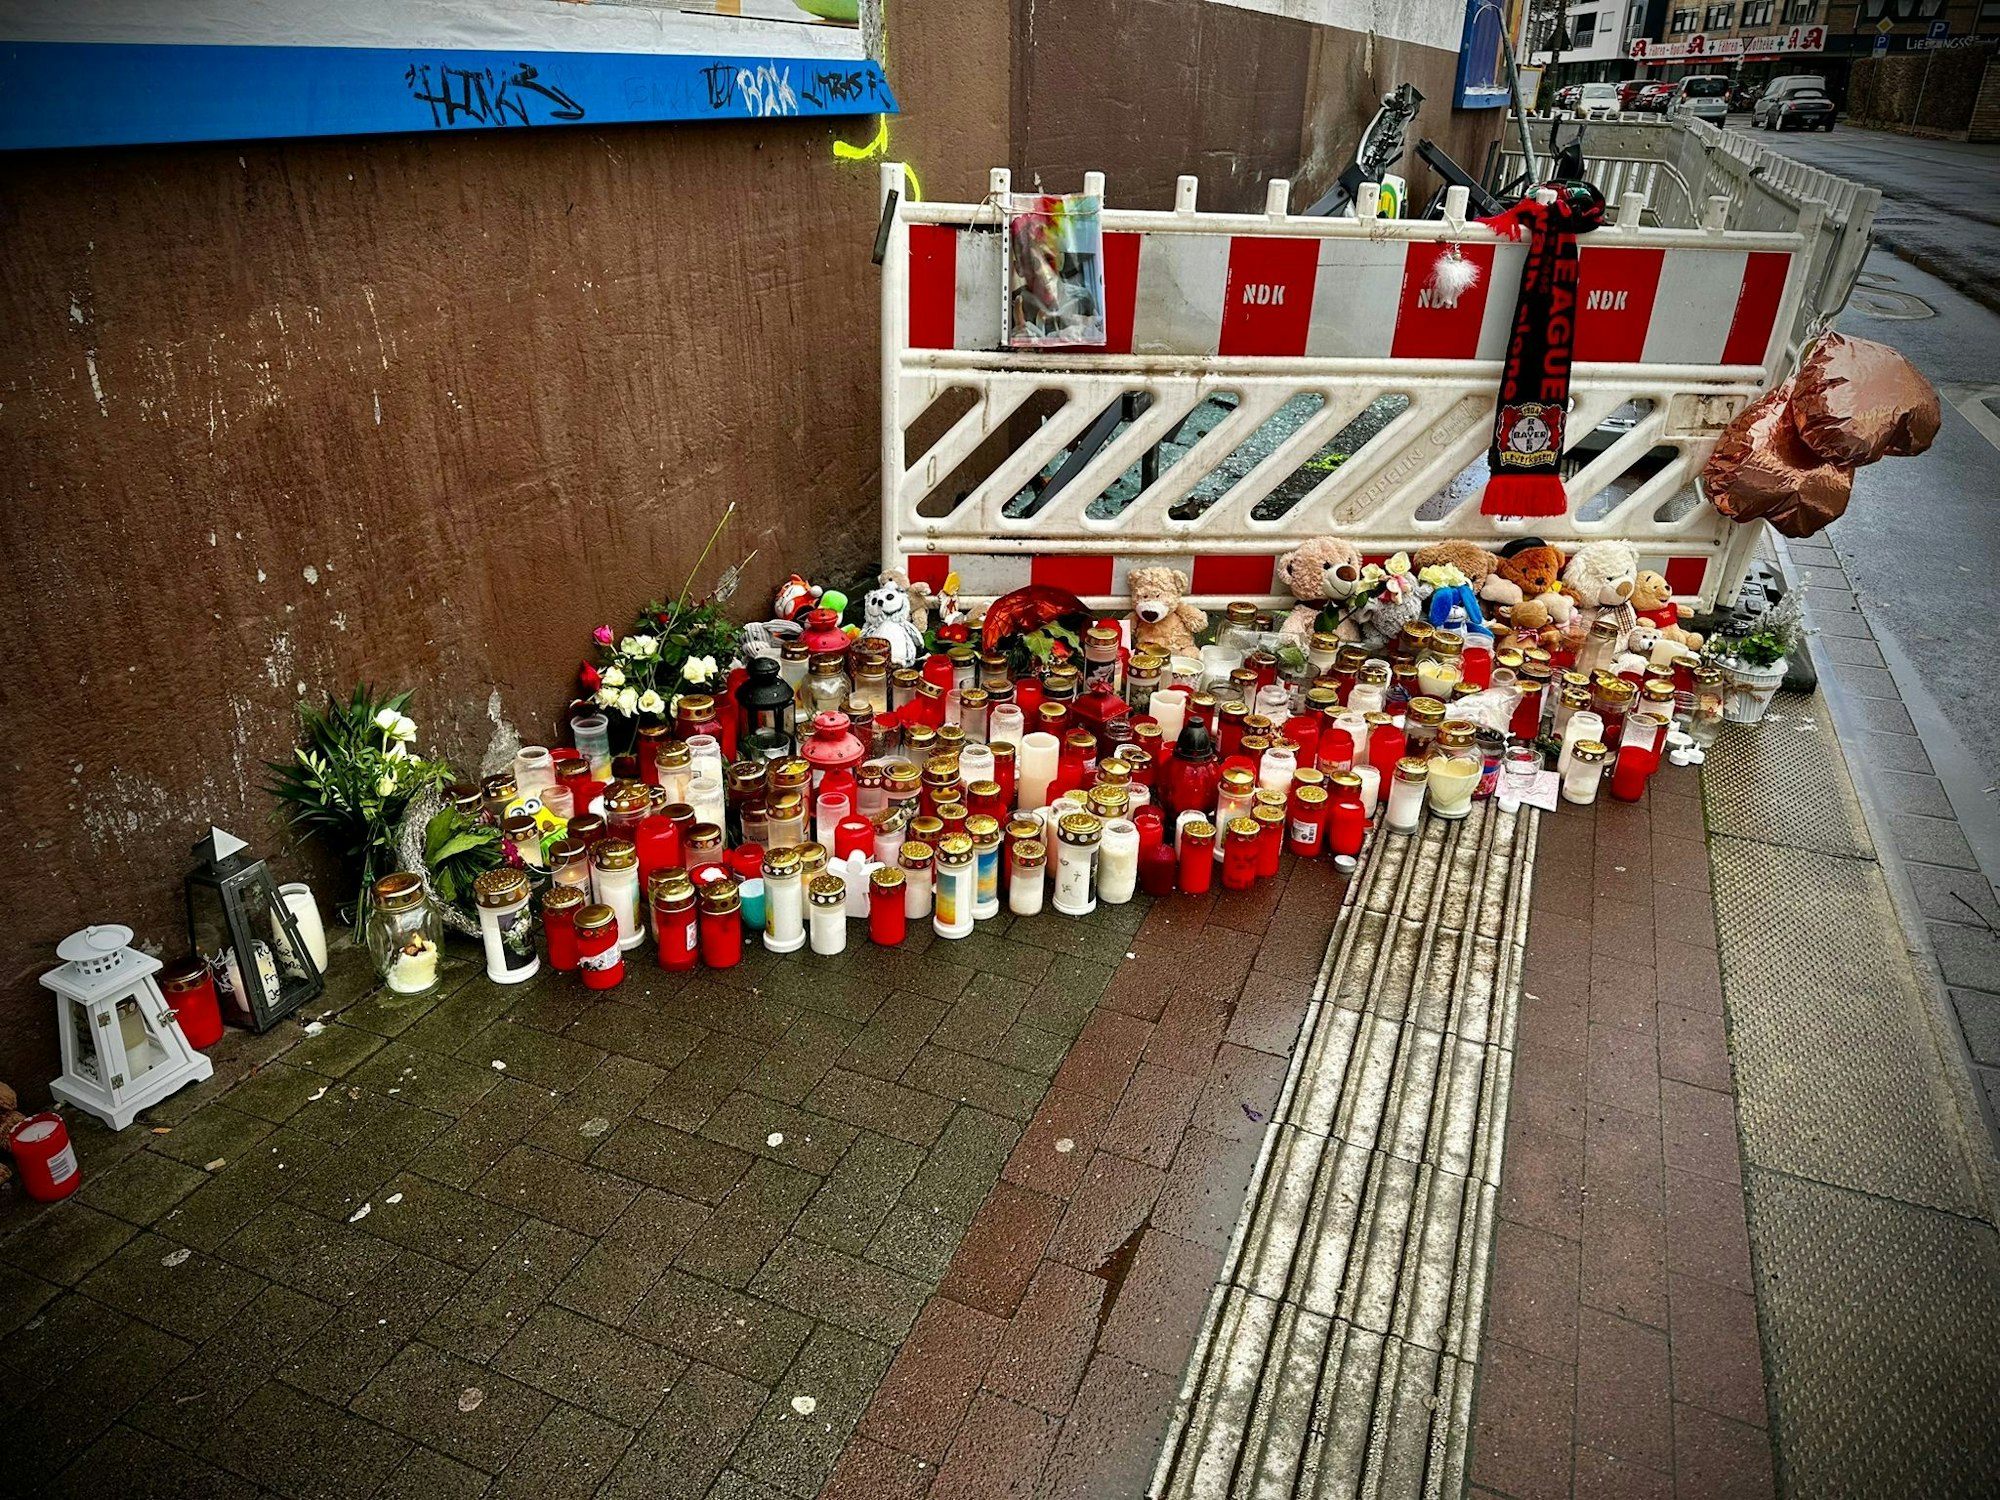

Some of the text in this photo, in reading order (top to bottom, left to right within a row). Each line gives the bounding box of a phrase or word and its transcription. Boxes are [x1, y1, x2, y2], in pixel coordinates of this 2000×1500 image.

[1932, 22, 1946, 37] P
[1876, 36, 1887, 48] P
[1243, 283, 1286, 305] NDK
[1586, 290, 1629, 310] NDK
[1540, 232, 1577, 401] LEAGUE
[1513, 431, 1547, 439] BAYER
